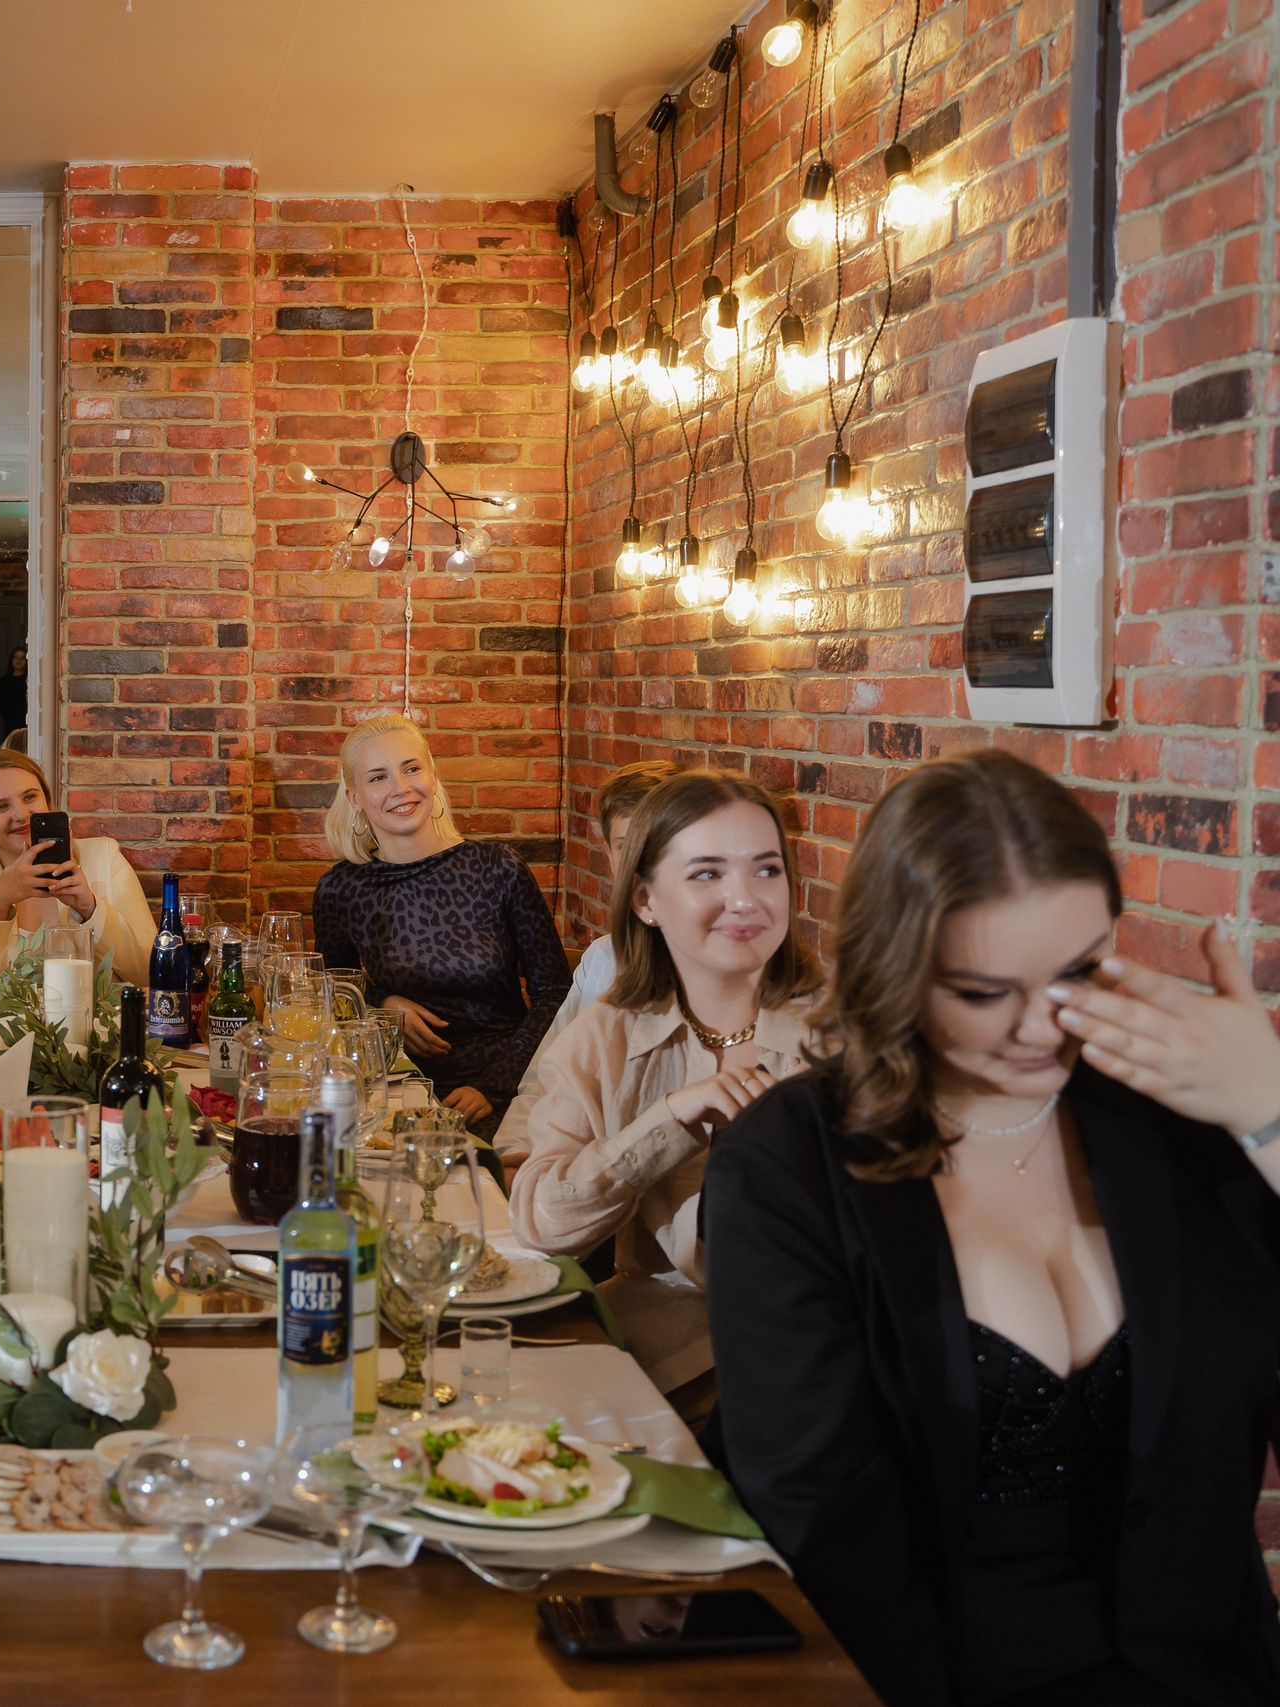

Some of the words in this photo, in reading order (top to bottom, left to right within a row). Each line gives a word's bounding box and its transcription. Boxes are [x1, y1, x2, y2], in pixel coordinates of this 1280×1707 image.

[210, 1019, 243, 1029] WILLIAM
[290, 1269, 342, 1292] ПЯТЬ
[290, 1289, 342, 1311] ОЗЕР
